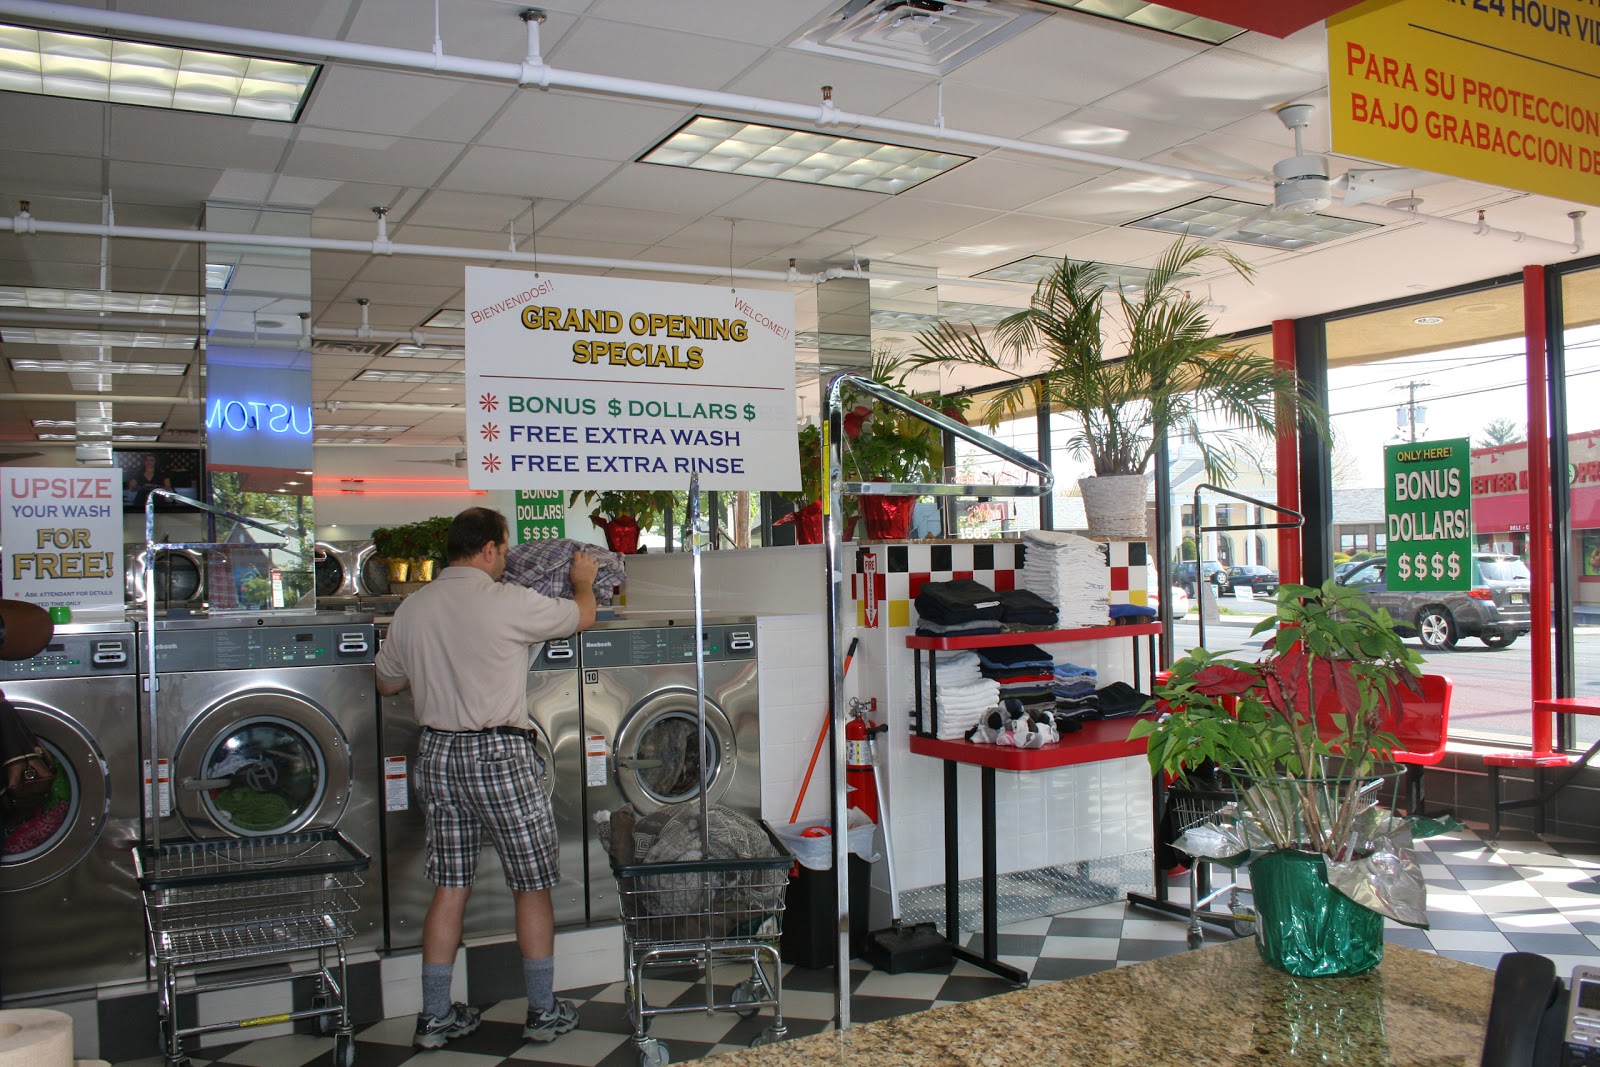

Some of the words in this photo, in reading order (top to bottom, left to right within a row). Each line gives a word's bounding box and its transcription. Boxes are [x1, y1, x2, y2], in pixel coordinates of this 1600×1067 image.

[1511, 0, 1572, 37] HOUR
[1346, 41, 1419, 92] PARA
[1424, 68, 1456, 101] SU
[1462, 77, 1600, 137] PROTECCION
[1351, 92, 1419, 134] BAJO
[1425, 110, 1573, 169] GRABACCION
[470, 280, 554, 324] BIENVENIDOS!!
[521, 305, 624, 334] GRAND
[629, 312, 749, 342] OPENING
[734, 297, 790, 340] WELCOME!!
[572, 339, 705, 370] SPECIALS
[508, 395, 597, 416] BONUS
[510, 425, 578, 443] FREE
[585, 427, 667, 445] EXTRA
[670, 429, 740, 446] WASH
[511, 455, 580, 472] FREE
[586, 456, 668, 473] EXTRA
[674, 457, 745, 474] RINSE
[1397, 449, 1421, 462] ONLY
[1423, 447, 1452, 459] HERE!
[10, 478, 112, 499] UPSIZE
[1395, 467, 1461, 501] BONUS
[1472, 473, 1517, 494] ETTER
[521, 490, 560, 499] BONUS
[12, 505, 58, 518] YOUR
[62, 505, 111, 517] WASH
[517, 504, 564, 520] DOLLARS!
[1388, 509, 1470, 542] DOLLARS!
[37, 528, 92, 549] FOR
[13, 552, 114, 580] FREE!
[864, 560, 875, 570] FIRE
[586, 672, 597, 681] 10
